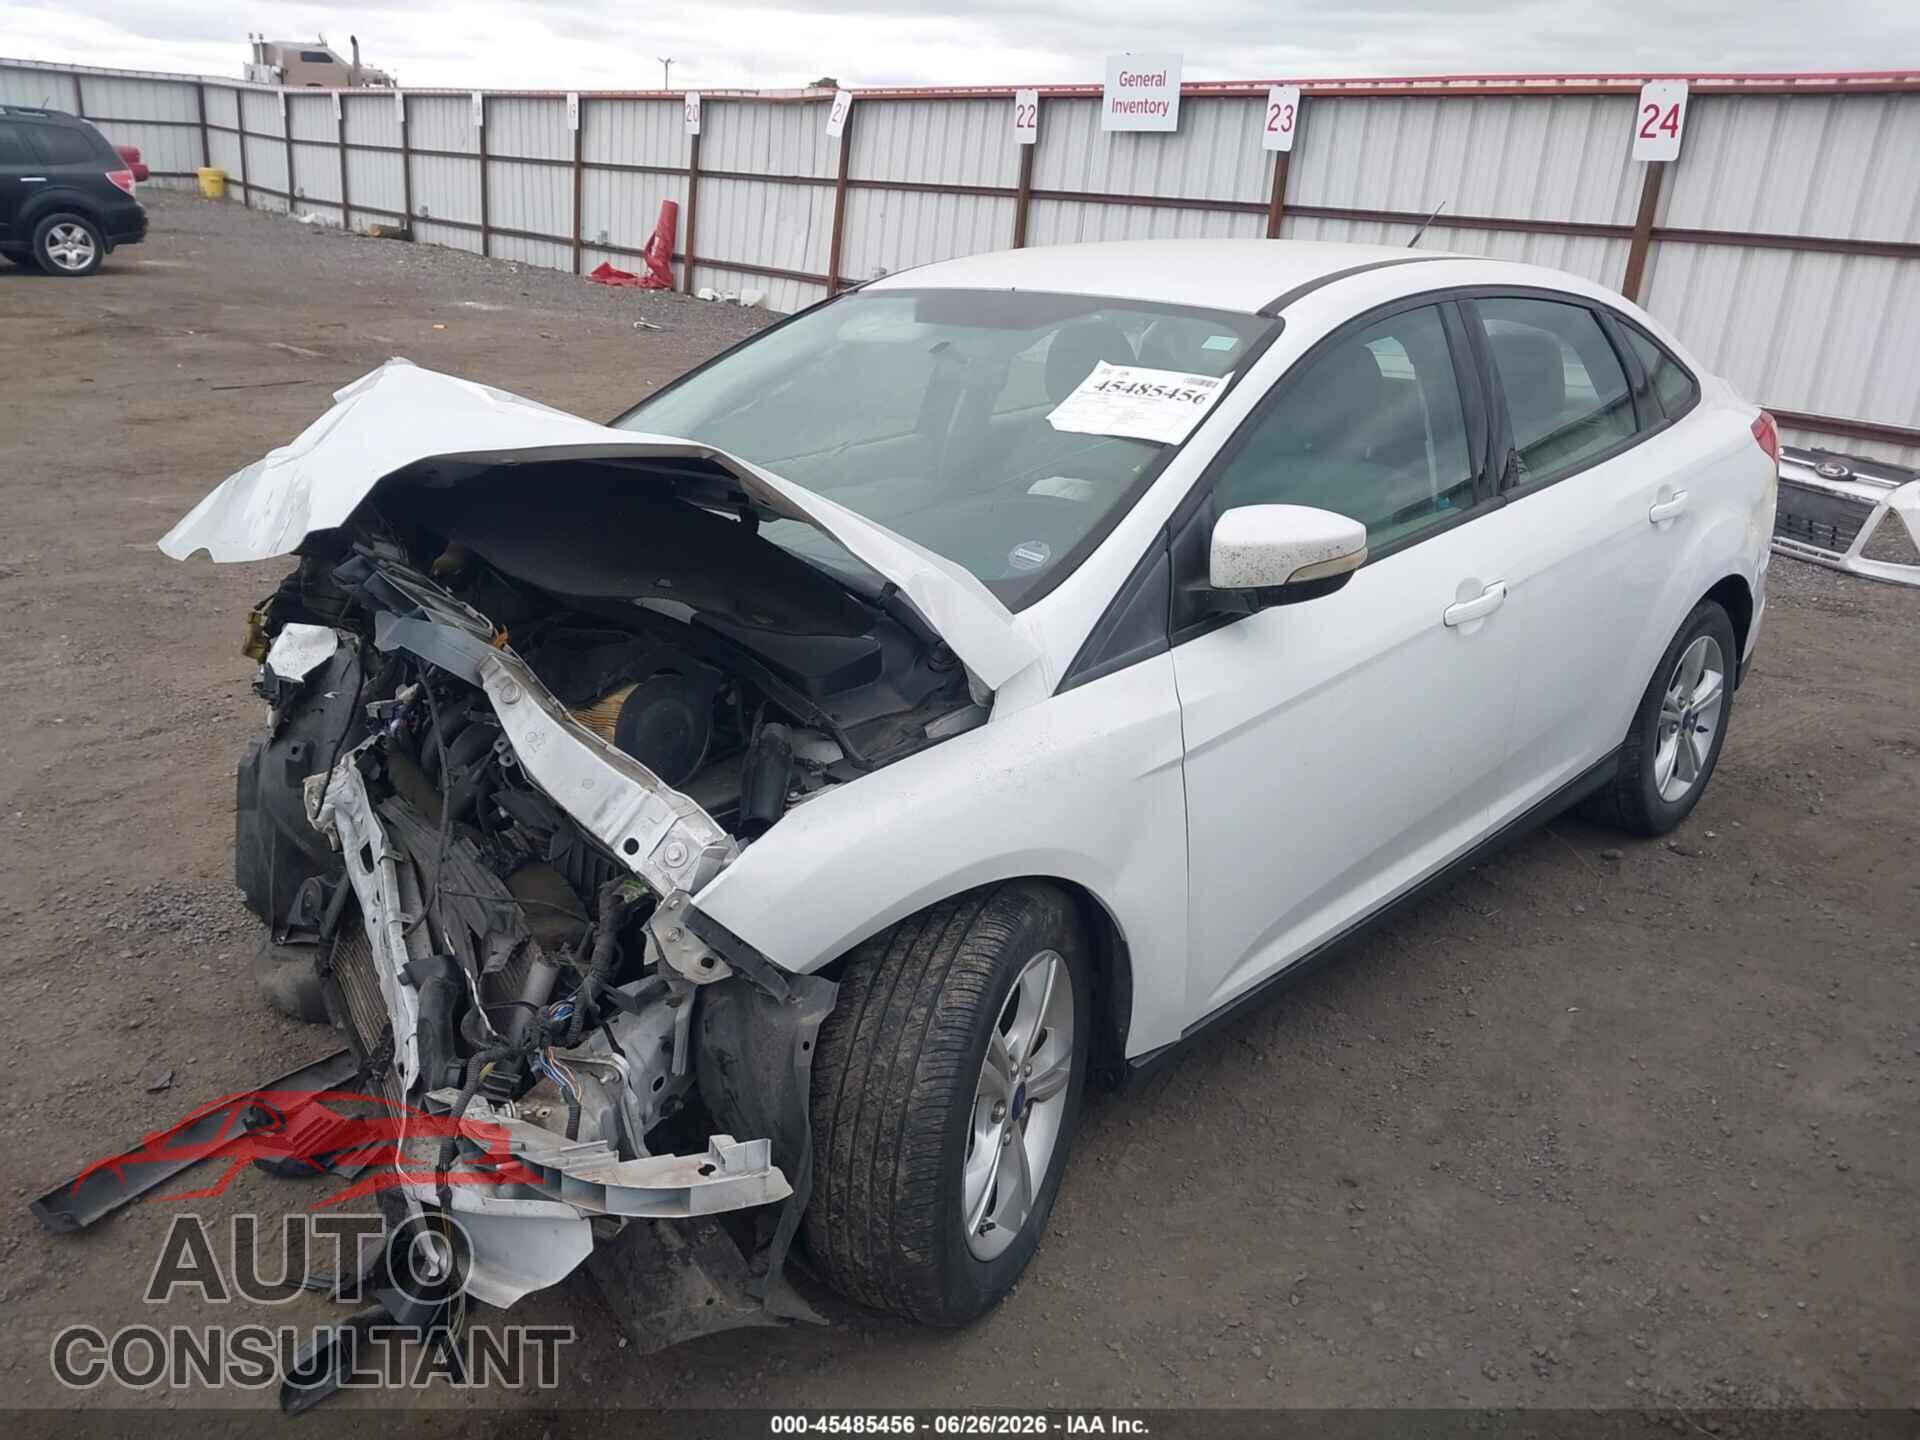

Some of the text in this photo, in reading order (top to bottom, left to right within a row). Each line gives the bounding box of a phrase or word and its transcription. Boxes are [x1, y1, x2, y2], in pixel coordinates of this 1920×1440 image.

[1119, 70, 1167, 89] General
[686, 103, 699, 122] 20
[832, 102, 847, 122] 21
[1016, 104, 1036, 129] 22
[1111, 96, 1170, 119] Inventory
[1267, 103, 1295, 133] 23
[1640, 103, 1680, 139] 24
[1095, 379, 1208, 405] 45485456
